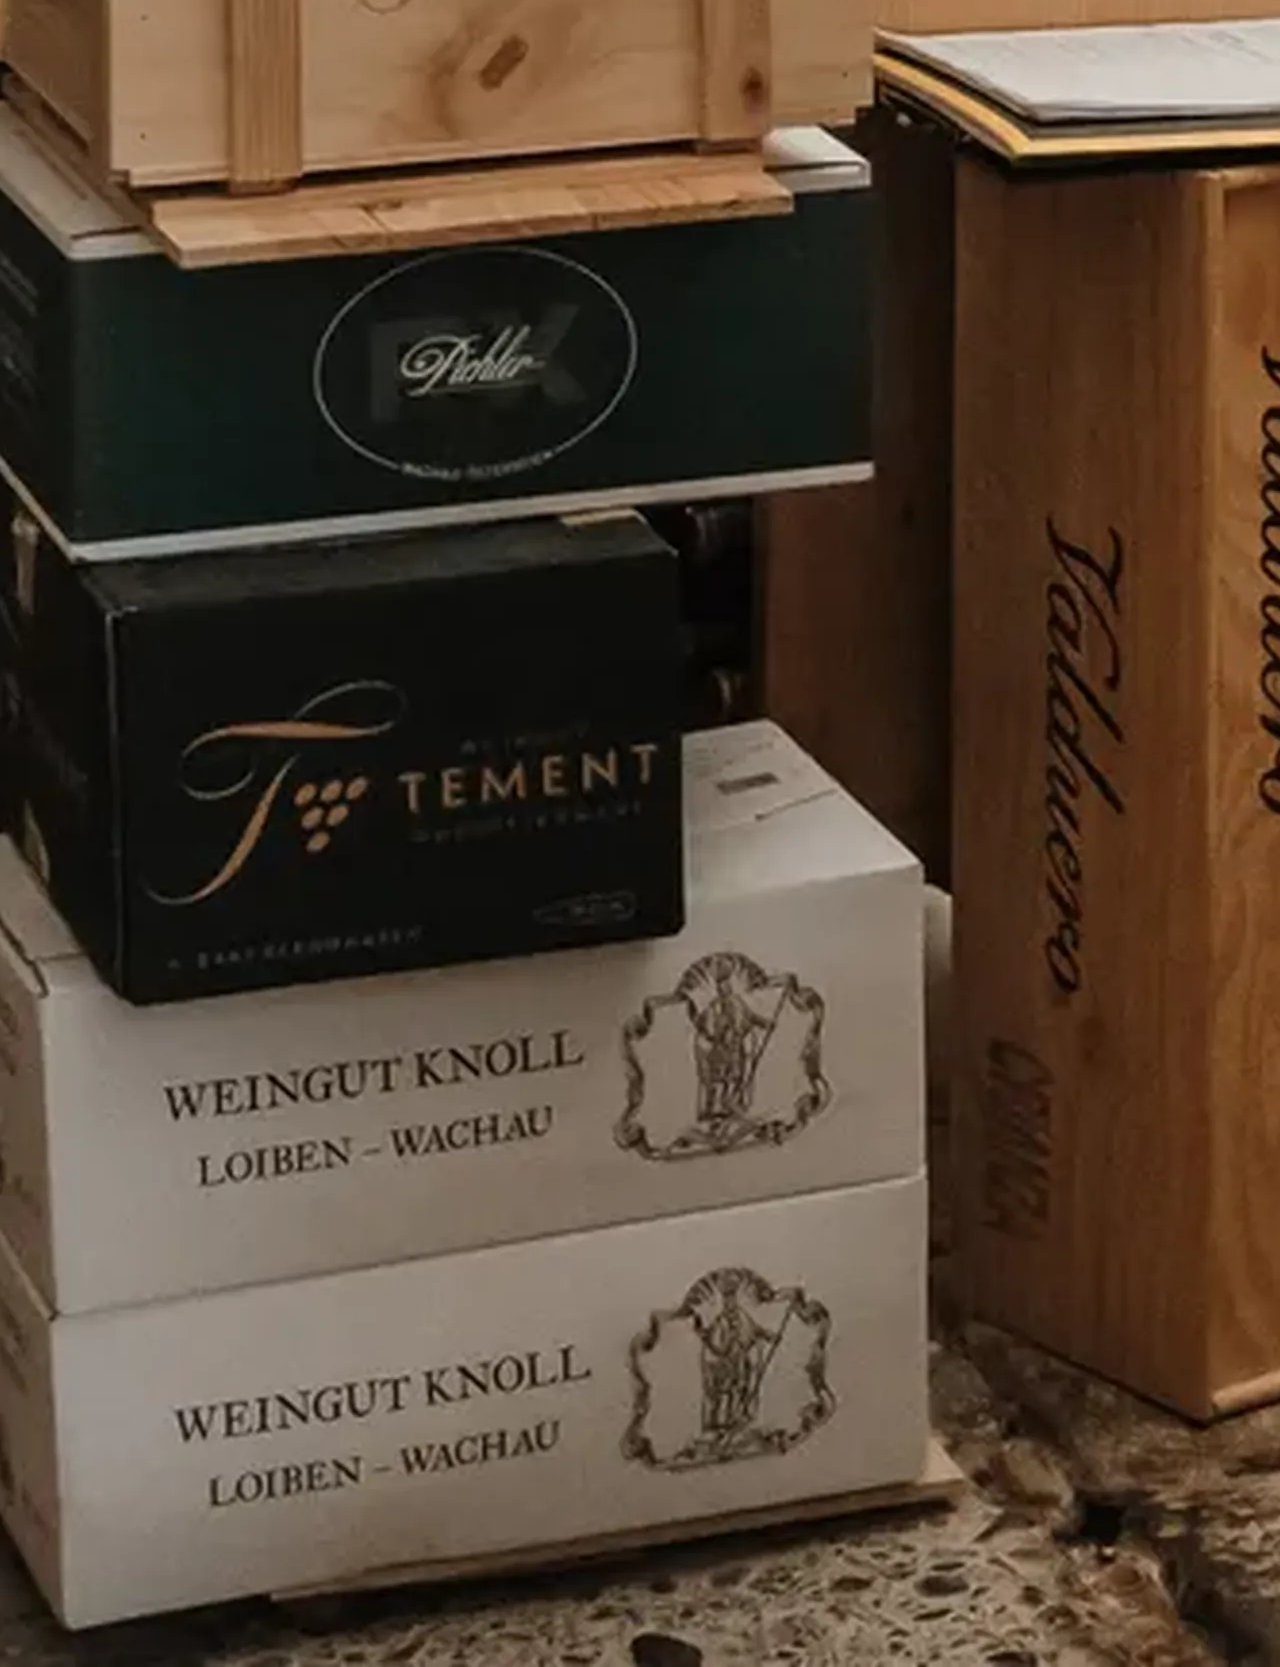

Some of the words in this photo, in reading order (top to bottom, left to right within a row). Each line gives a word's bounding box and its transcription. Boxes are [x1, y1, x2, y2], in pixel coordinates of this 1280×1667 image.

[398, 743, 658, 814] TEMENT
[1046, 516, 1125, 996] Valduero
[163, 1056, 404, 1122] WEINGUT
[414, 1030, 586, 1089] KNOLL
[197, 1136, 353, 1188] LOIBEN
[390, 1105, 554, 1158] WACHAU
[173, 1374, 412, 1443] WEINGUT
[422, 1344, 593, 1407] KNOLL
[209, 1455, 362, 1508] LOIBEN
[399, 1419, 561, 1475] WACHAU
